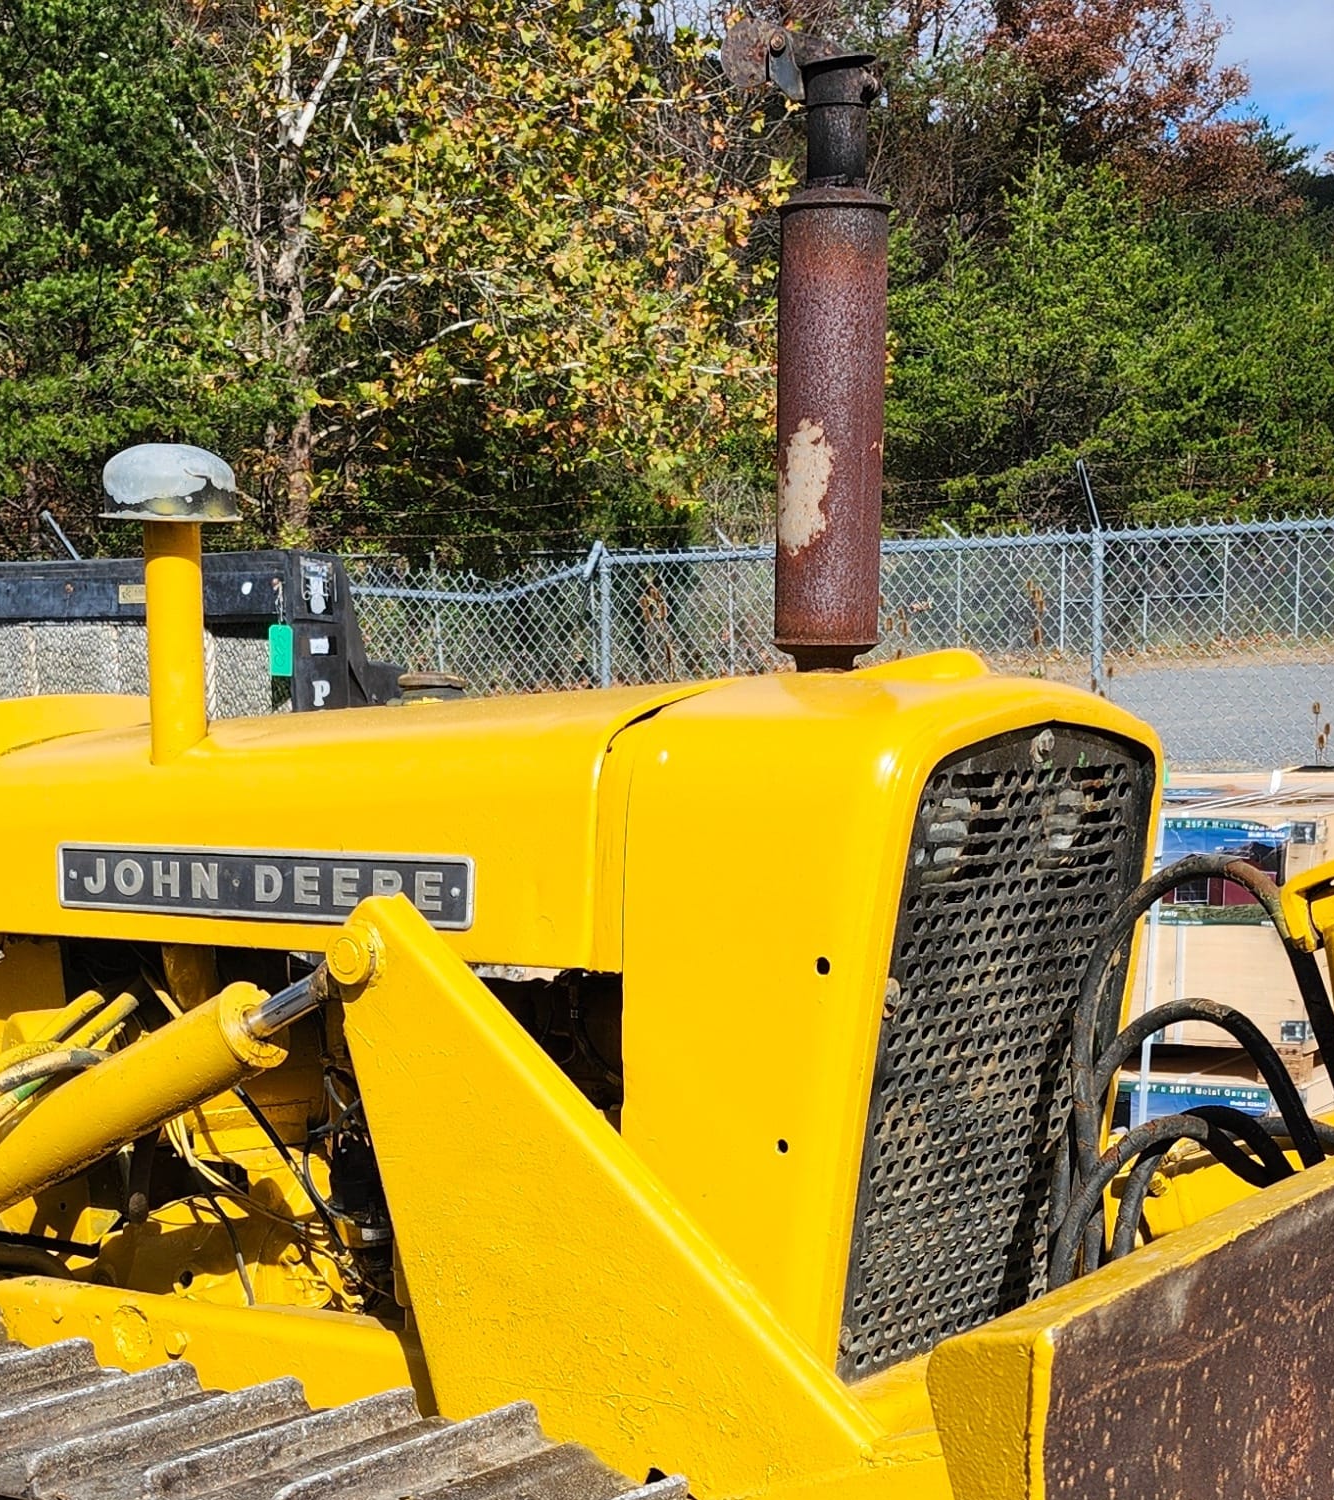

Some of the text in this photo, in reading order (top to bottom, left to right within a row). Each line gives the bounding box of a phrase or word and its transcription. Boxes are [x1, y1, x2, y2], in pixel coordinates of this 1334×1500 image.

[311, 680, 330, 706] P
[83, 858, 444, 912] JOHN DEERE
